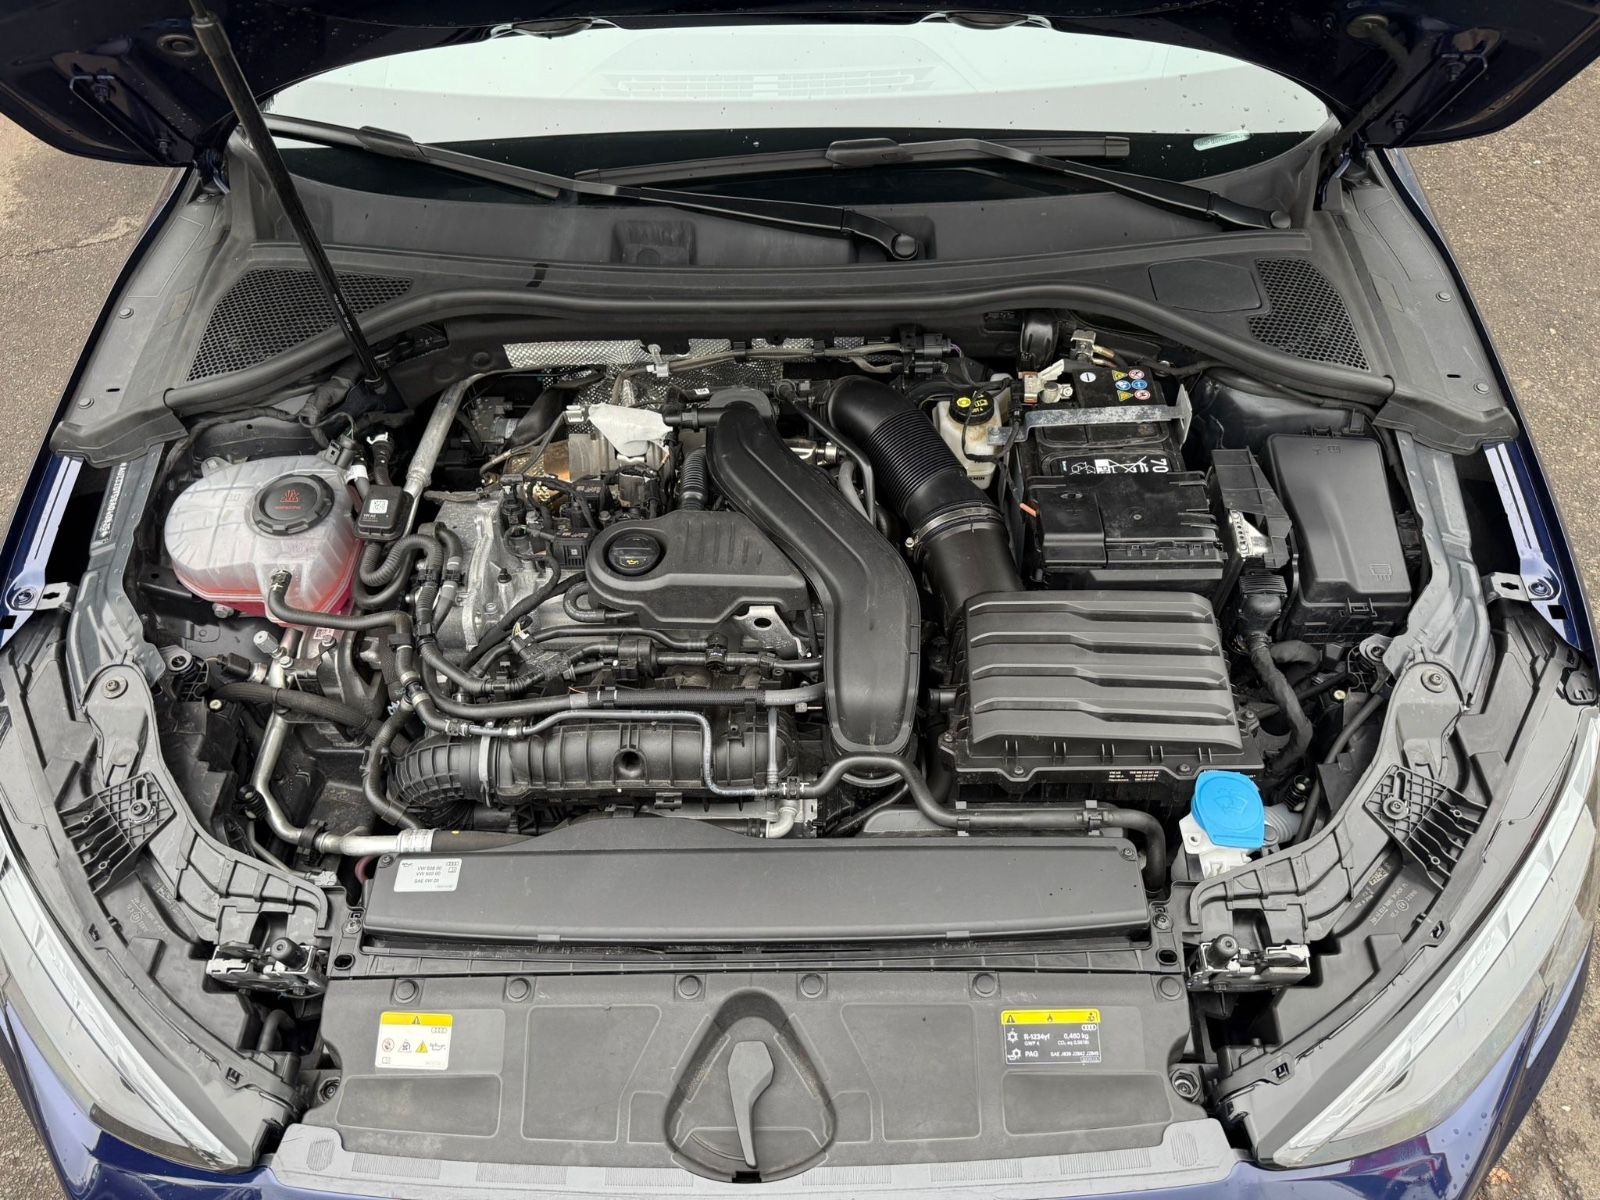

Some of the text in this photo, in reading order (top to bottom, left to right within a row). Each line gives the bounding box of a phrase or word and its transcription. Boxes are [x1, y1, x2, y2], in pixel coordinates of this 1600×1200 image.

[1149, 458, 1169, 473] 70
[1023, 1033, 1050, 1041] R-1234yf
[1081, 1032, 1089, 1040] kg
